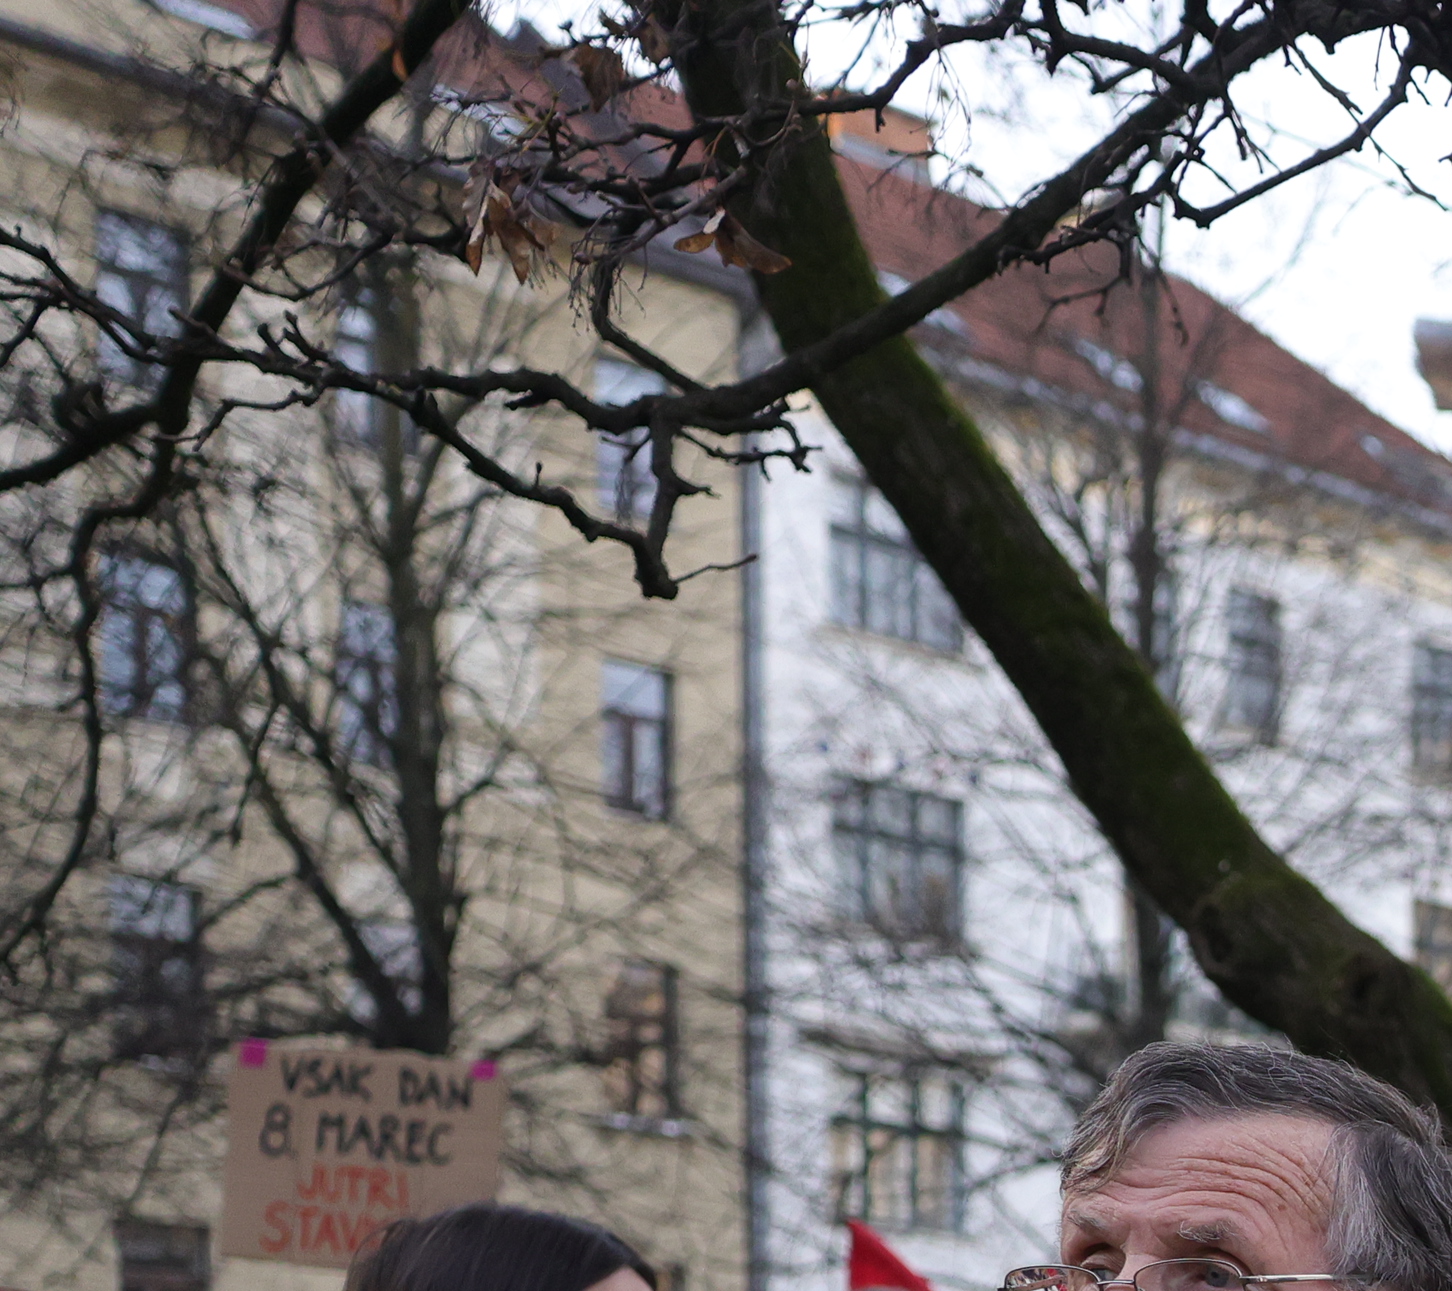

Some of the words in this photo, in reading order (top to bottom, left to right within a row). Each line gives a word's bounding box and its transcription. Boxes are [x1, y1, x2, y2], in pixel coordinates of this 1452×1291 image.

[280, 1054, 375, 1104] VSAK
[398, 1065, 474, 1111] DAN
[316, 1111, 454, 1167] MAREC
[297, 1161, 410, 1210] JUTRI
